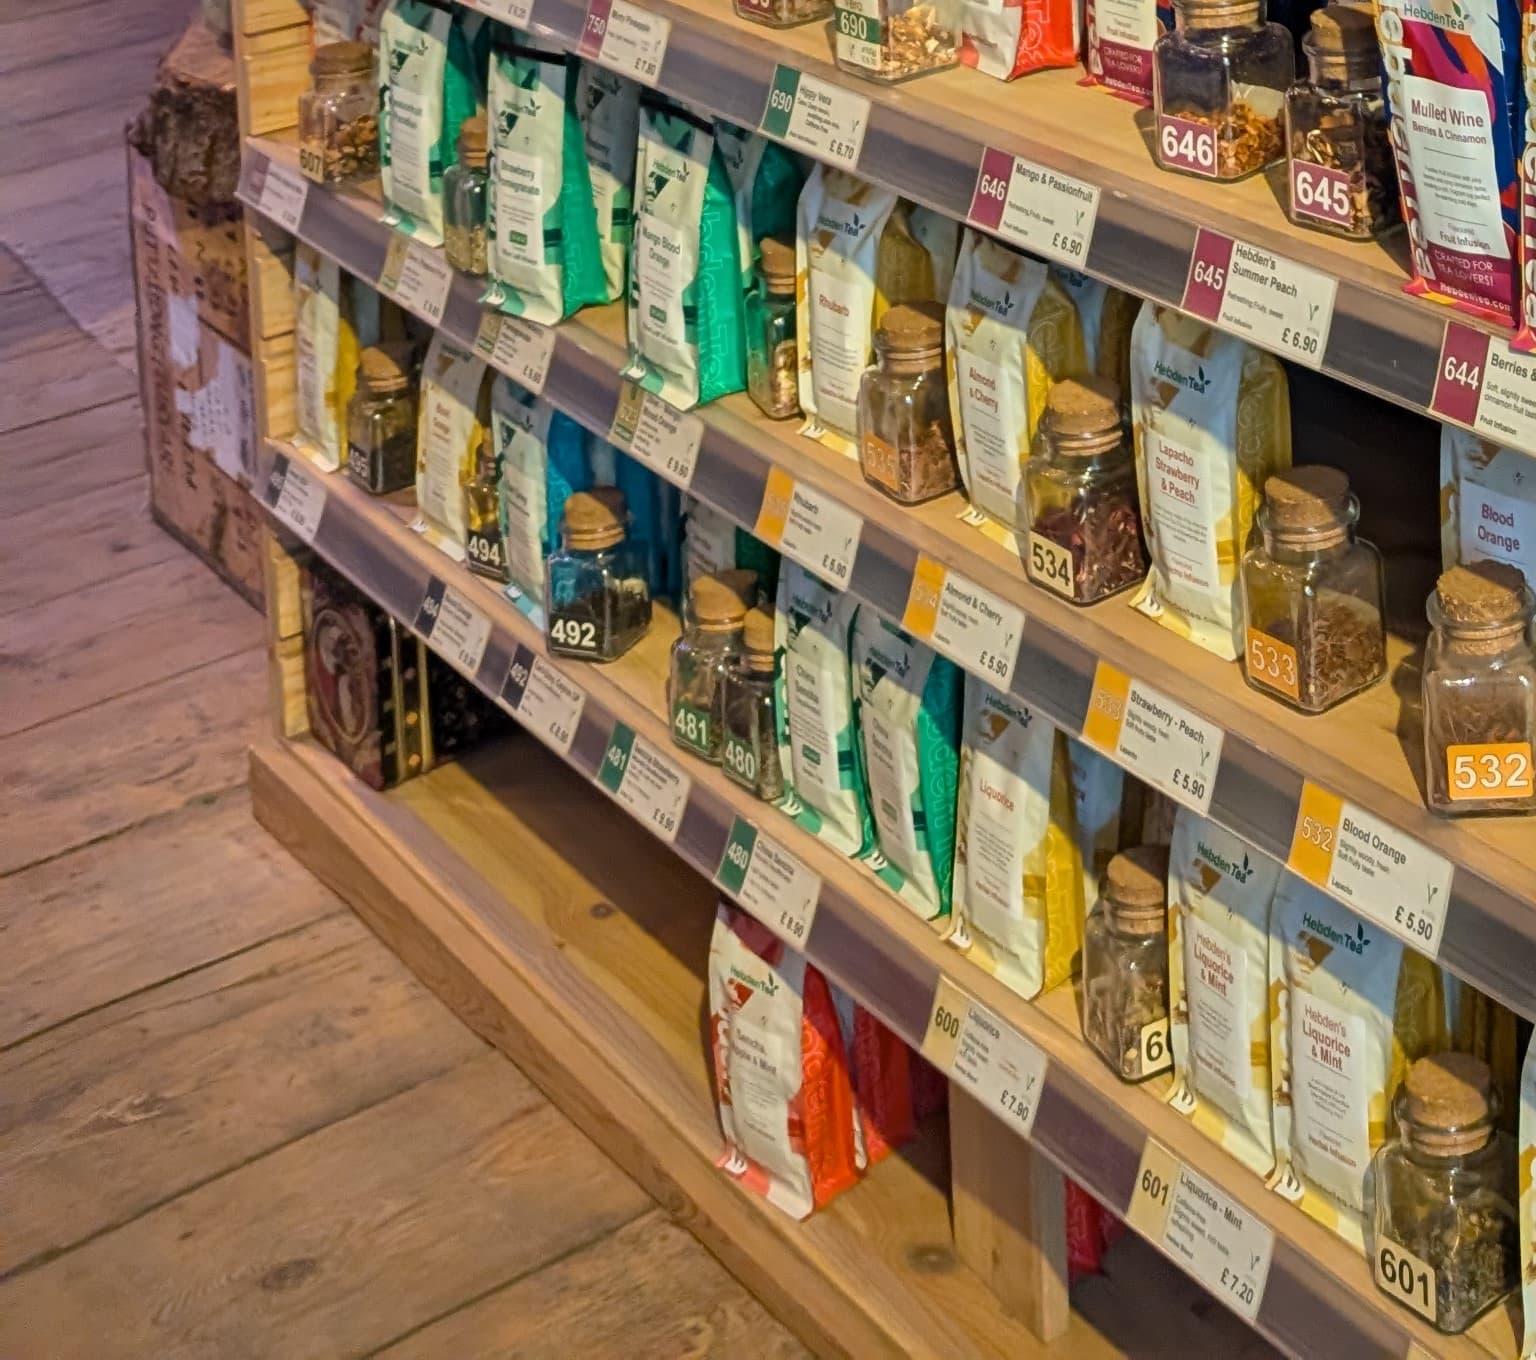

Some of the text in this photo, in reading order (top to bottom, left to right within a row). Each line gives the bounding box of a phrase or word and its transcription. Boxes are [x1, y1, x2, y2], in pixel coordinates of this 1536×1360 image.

[841, 12, 867, 38] 690
[1161, 127, 1212, 164] 646
[1296, 171, 1350, 213] 645
[1490, 353, 1529, 382] Berries
[1030, 542, 1070, 586] 534
[551, 619, 596, 647] 492
[675, 708, 708, 746] 481
[1453, 754, 1529, 788] 532
[1342, 818, 1406, 864] Blood Orange
[1141, 1169, 1170, 1205] 601
[1379, 1248, 1431, 1307] 601
